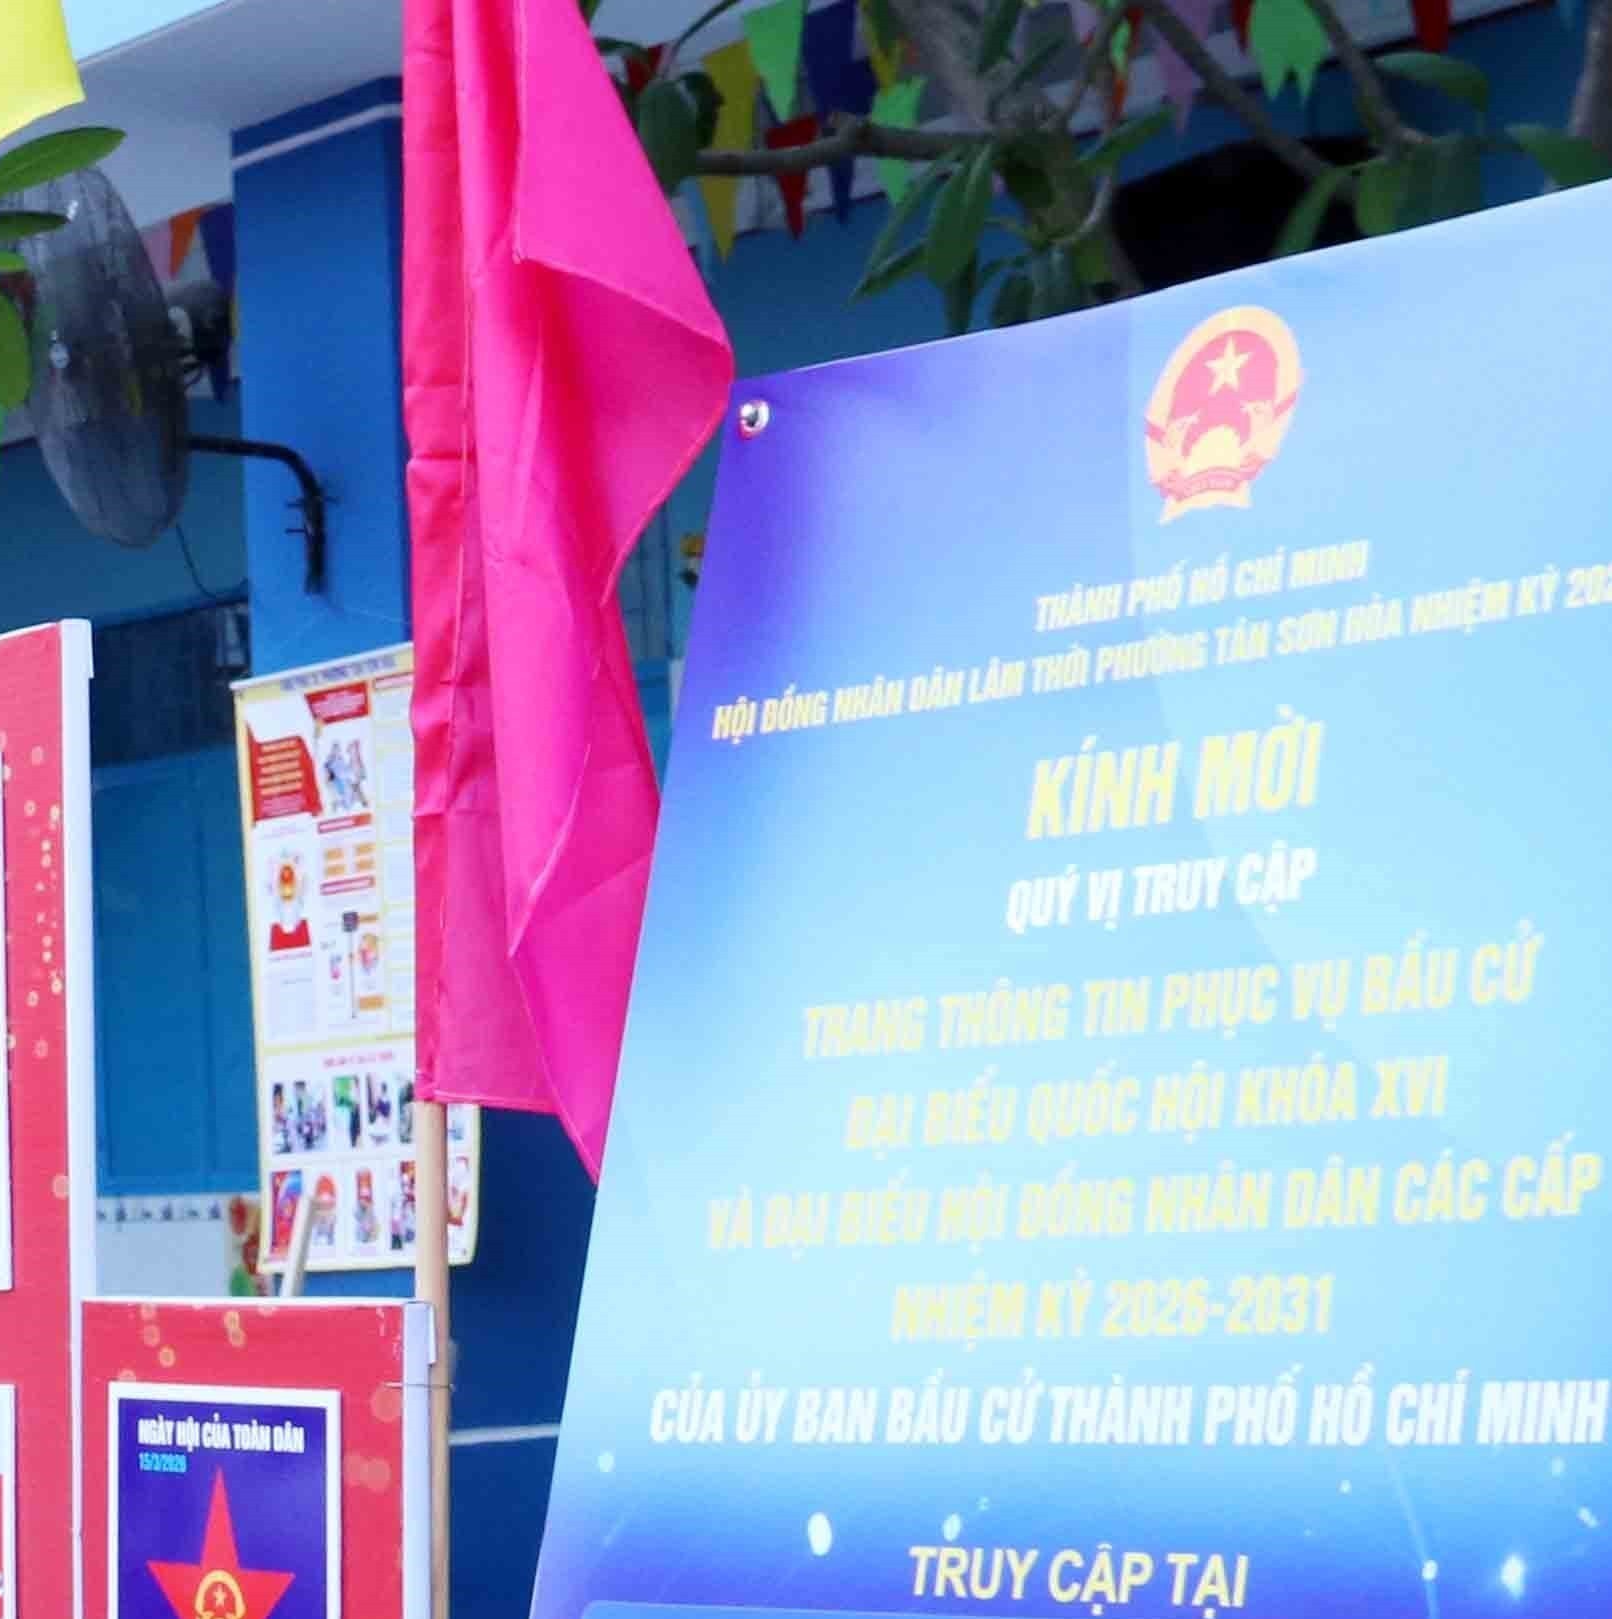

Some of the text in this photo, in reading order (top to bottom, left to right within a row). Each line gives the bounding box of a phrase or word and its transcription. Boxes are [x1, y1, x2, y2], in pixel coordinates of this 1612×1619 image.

[1034, 580, 1122, 632] THÀNH
[1127, 558, 1188, 617] PHỐ
[1234, 546, 1286, 600] CHÍ
[1289, 538, 1371, 590] MINH
[712, 695, 757, 744] HỘI
[833, 673, 904, 722] NHÂN
[909, 664, 963, 711] DÂN
[969, 656, 1025, 702] LÂM
[1214, 618, 1270, 666] TÂN
[1277, 606, 1337, 655] SƠN
[1343, 592, 1402, 646] HÒA
[1411, 576, 1509, 638] NHIỆM
[1517, 564, 1560, 616] KỲ
[1025, 703, 1325, 840] KÍNH MỜI
[1005, 839, 1319, 936] QUÝ VỊ TRUY CẬP
[804, 917, 1546, 1059] TRANG THÔNG TIN PHỤC VỤ BẦU CỬ
[844, 1092, 914, 1161] ĐẠI
[1028, 1058, 1140, 1145] QUỐC
[1150, 1059, 1224, 1143] HỘI
[1235, 1050, 1357, 1127] KHÓA
[1369, 1054, 1449, 1120] XVI
[707, 1183, 753, 1251] VÀ
[762, 1191, 828, 1259] ĐẠI
[938, 1169, 1011, 1256] HỘI
[1144, 1158, 1275, 1235] NHÂN
[1284, 1152, 1381, 1229] DÂN
[1394, 1147, 1489, 1224] CÁC
[1502, 1128, 1604, 1220] CẤP
[892, 1267, 1335, 1350] NHIỆM KỲ 2026-2031
[649, 1361, 1610, 1447] CỦA ỦY BAN BẦU CỬ THÀNH PHỐ HỒ CHÍ MINH
[908, 1544, 1248, 1619] TRUY CẬP TẠI
